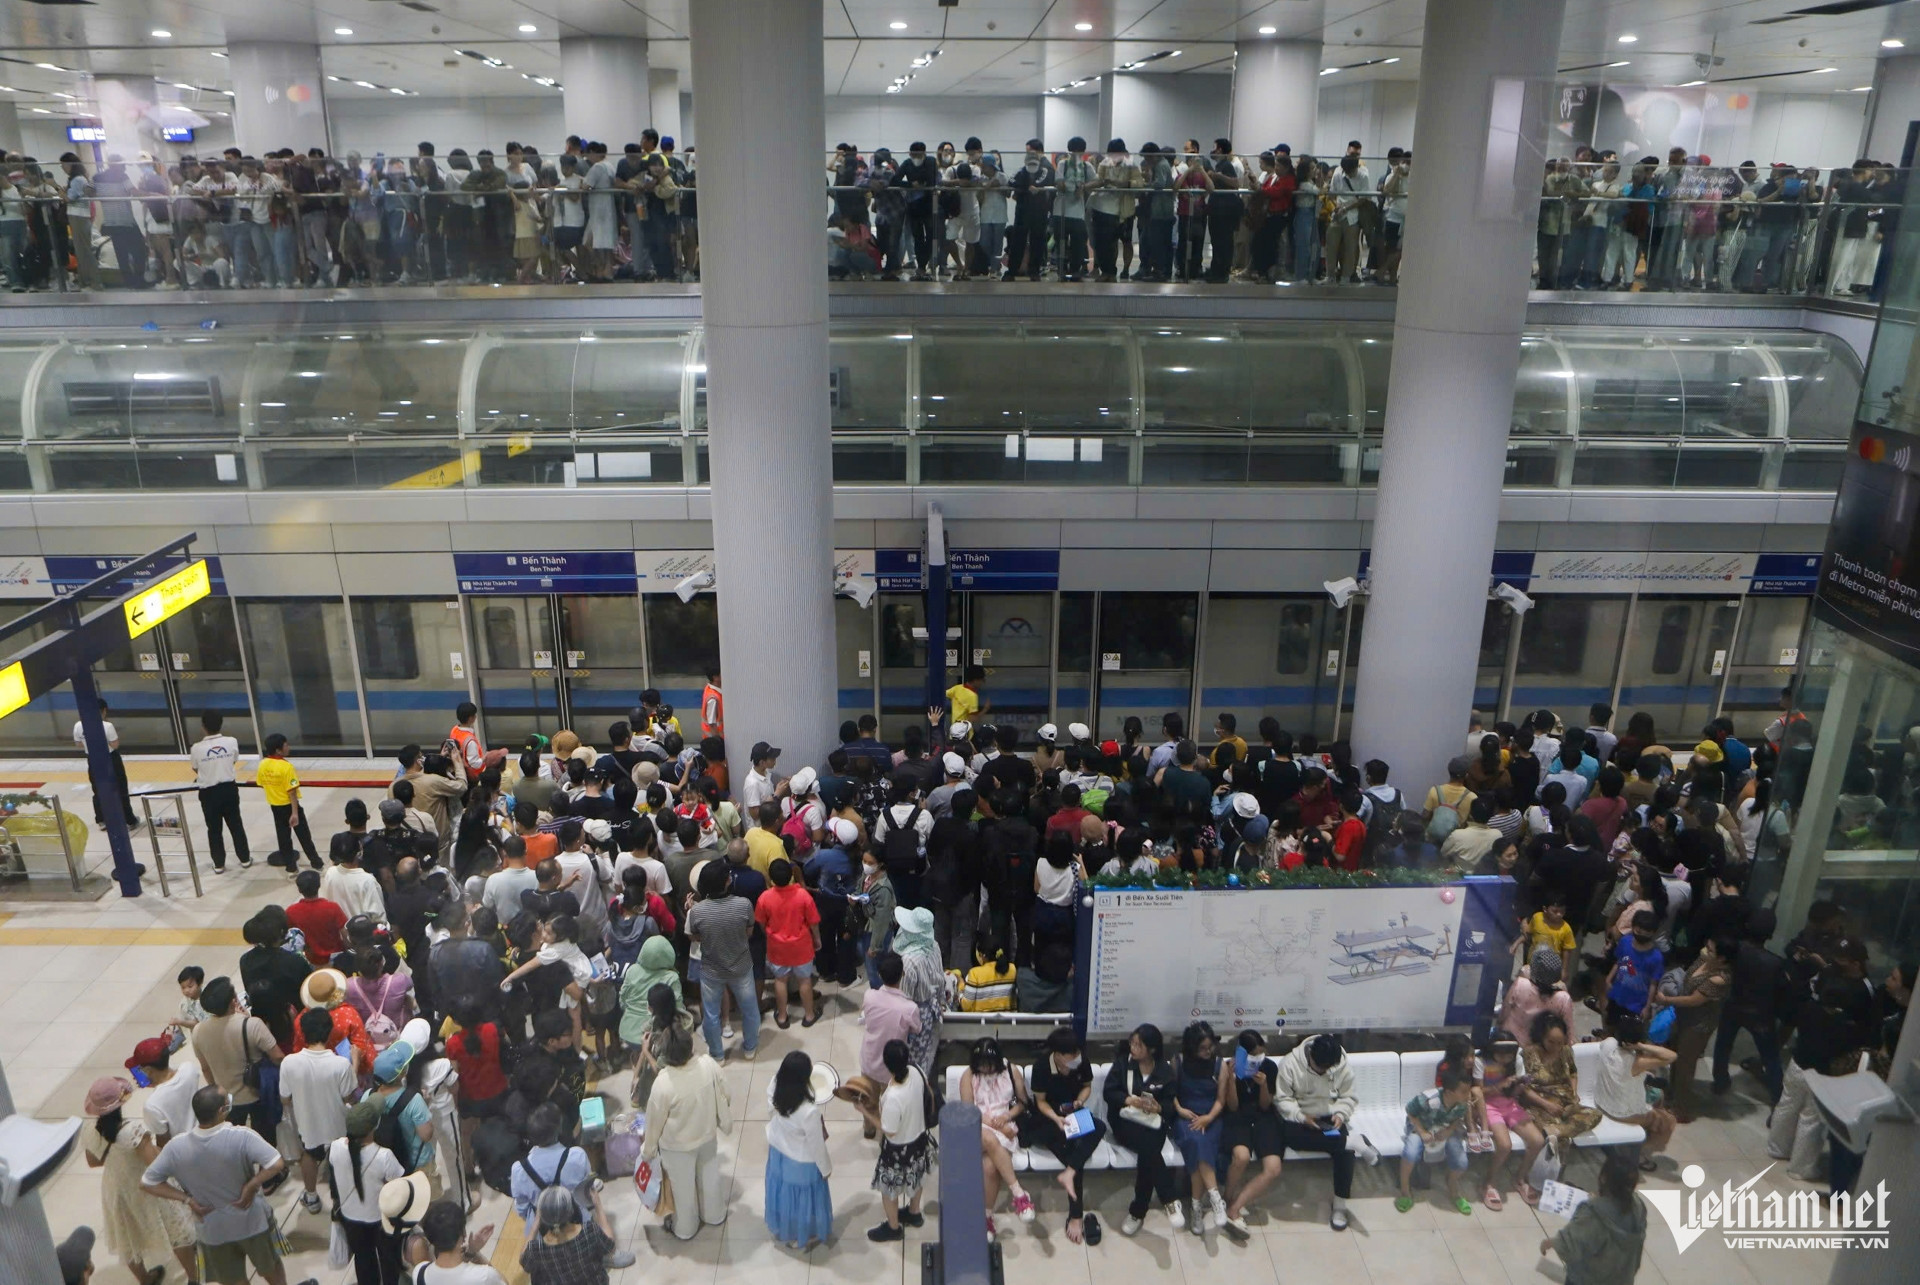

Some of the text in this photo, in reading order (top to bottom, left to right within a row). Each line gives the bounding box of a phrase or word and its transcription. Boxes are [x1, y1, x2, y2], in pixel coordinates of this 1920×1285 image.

[522, 556, 567, 565] Bến Thành
[964, 554, 990, 562] Thành
[1833, 553, 1918, 600] Thanh toán chạm
[1829, 571, 1838, 582] đi
[1838, 575, 1867, 596] Metro
[1867, 587, 1891, 605] miễn
[1892, 596, 1909, 615] phí
[1116, 895, 1121, 906] 1
